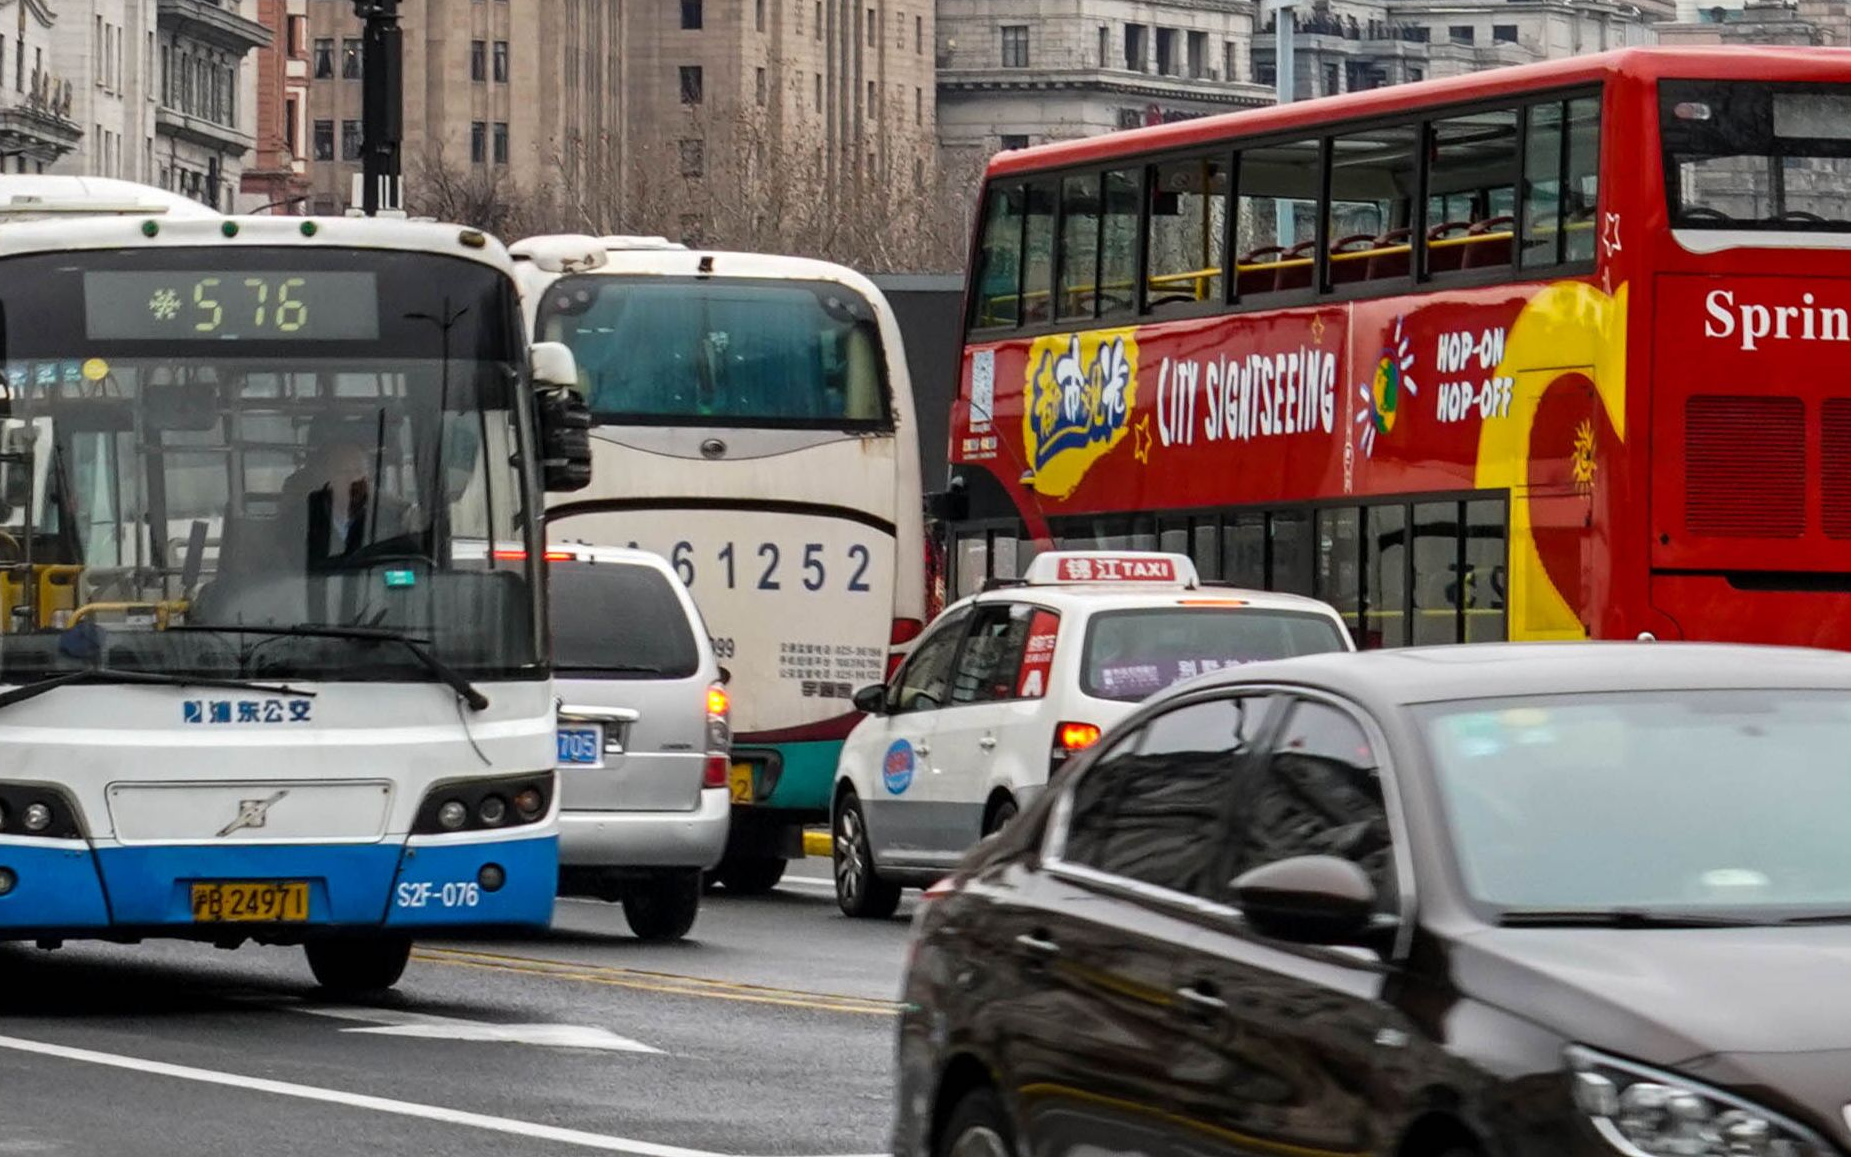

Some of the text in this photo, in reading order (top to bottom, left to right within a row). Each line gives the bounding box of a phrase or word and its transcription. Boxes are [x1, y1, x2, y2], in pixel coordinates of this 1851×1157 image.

[1436, 326, 1505, 374] HOP-ON
[1157, 344, 1336, 448] CITY SIGHTSEEING
[1436, 376, 1514, 423] HOP-OFF
[1122, 562, 1169, 578] TAXI
[397, 882, 480, 908] S2F-076
